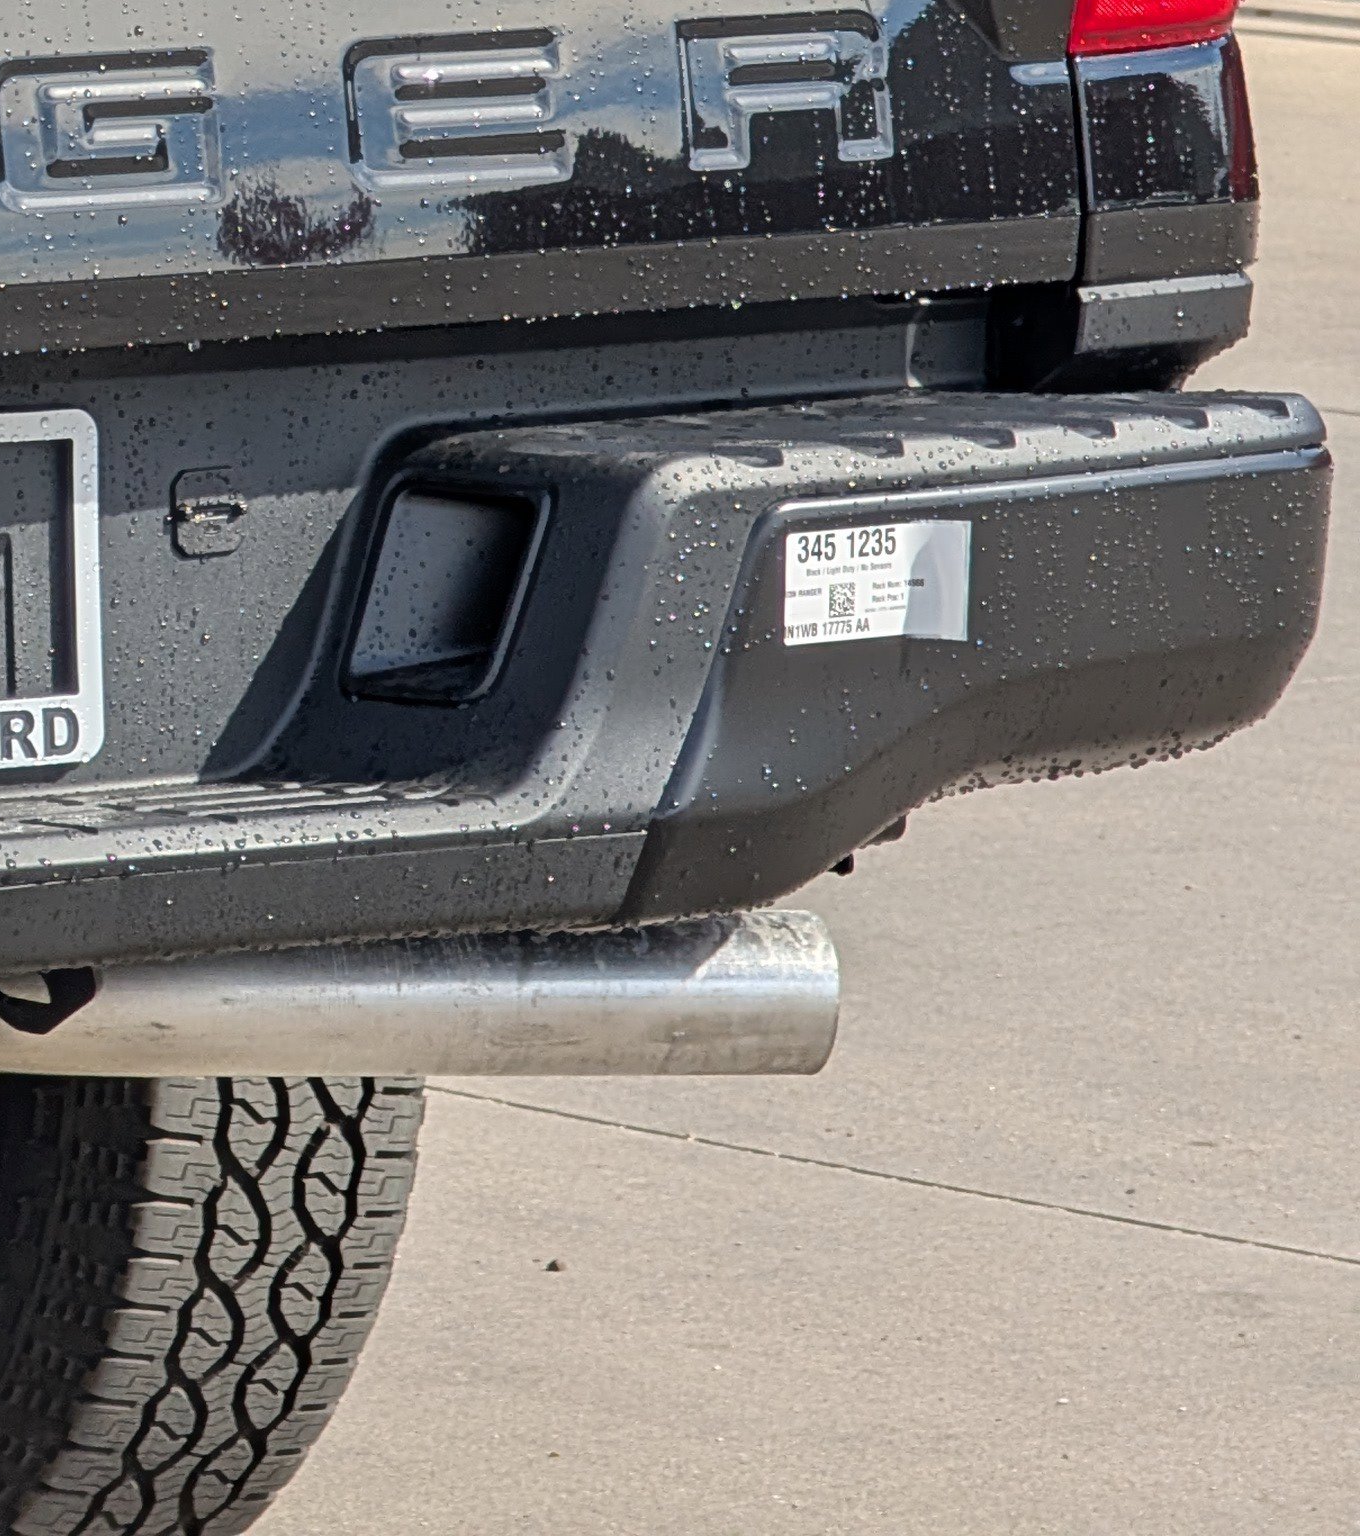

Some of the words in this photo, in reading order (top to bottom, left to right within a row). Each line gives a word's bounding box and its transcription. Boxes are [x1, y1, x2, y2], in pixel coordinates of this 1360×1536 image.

[797, 533, 836, 563] 345
[846, 527, 896, 558] 1235
[821, 619, 853, 635] 17775
[856, 617, 870, 633] AA
